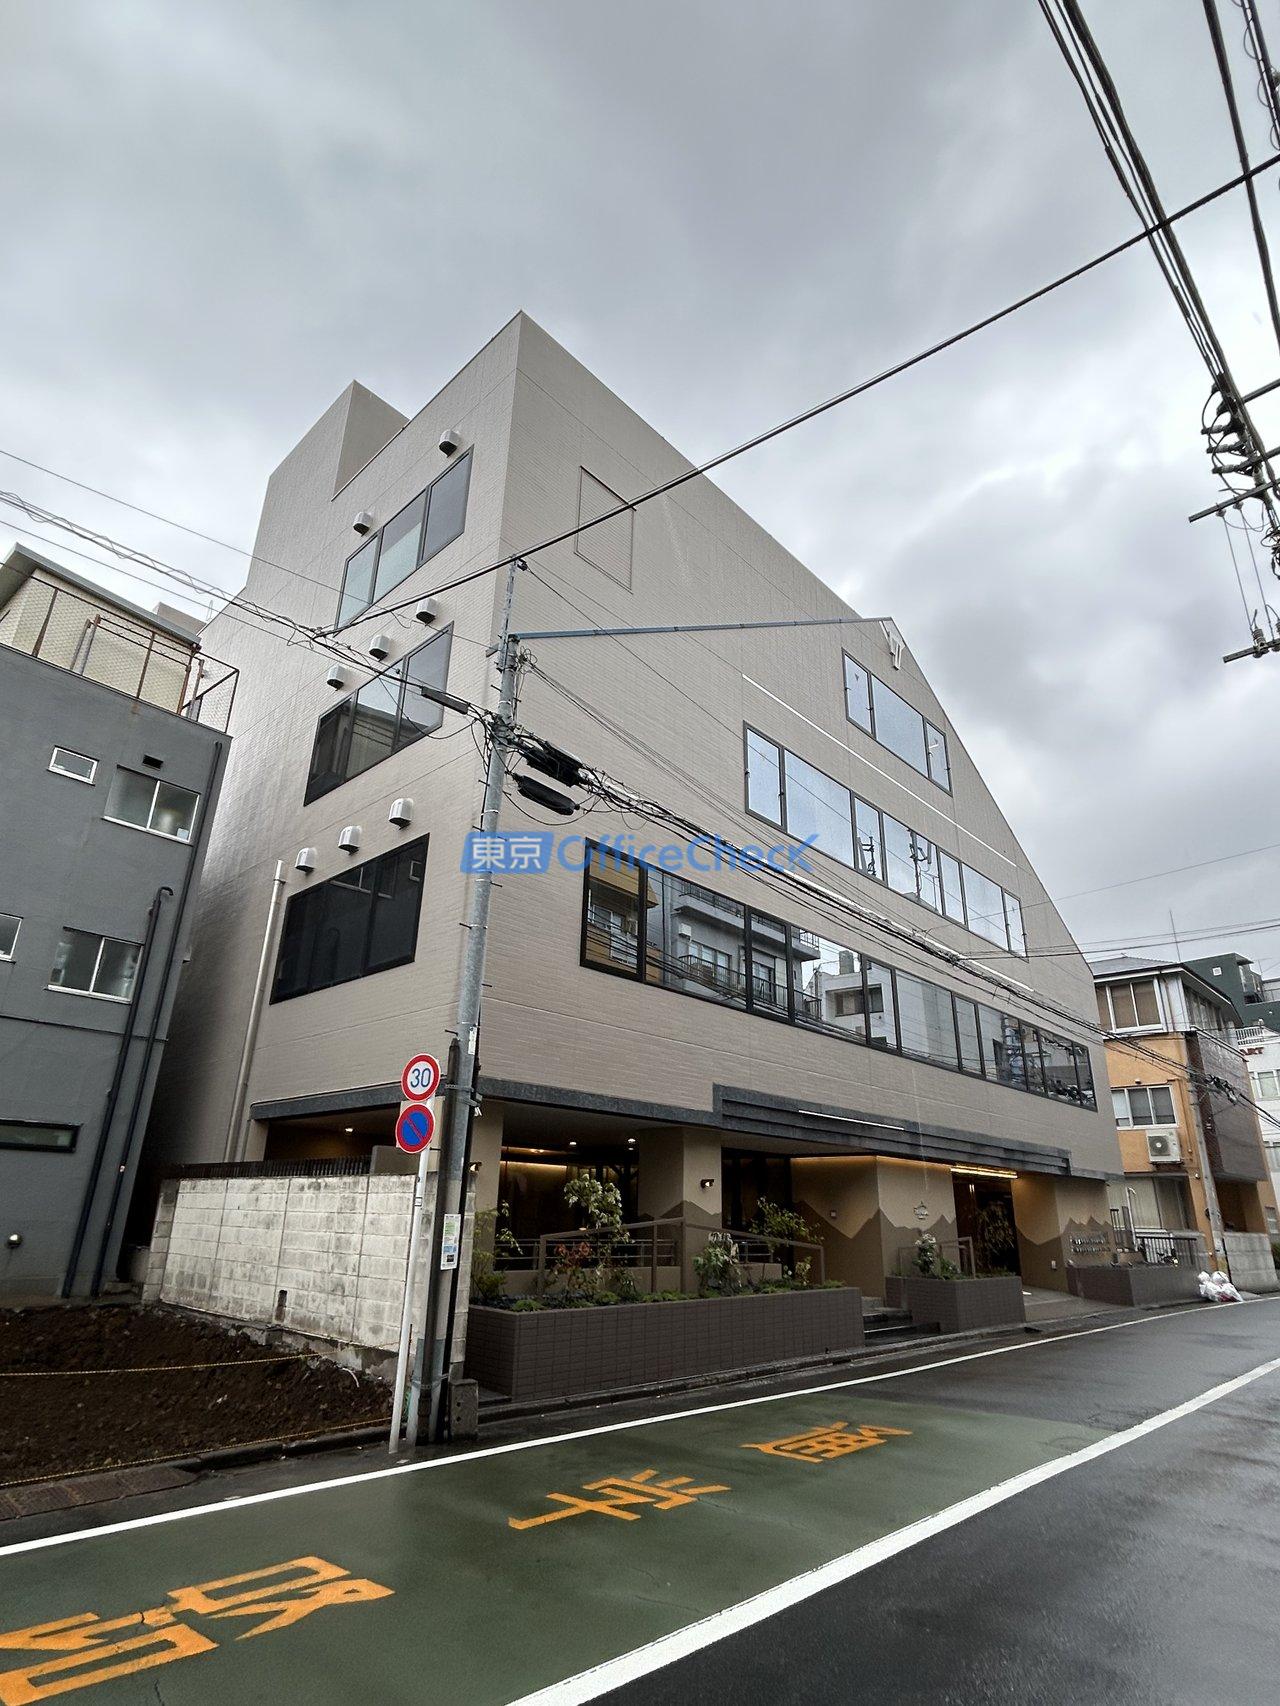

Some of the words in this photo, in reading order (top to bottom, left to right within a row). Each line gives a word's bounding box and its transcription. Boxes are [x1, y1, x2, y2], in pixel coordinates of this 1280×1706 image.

[410, 1067, 432, 1088] 30
[0, 1421, 913, 1704] 通学路
